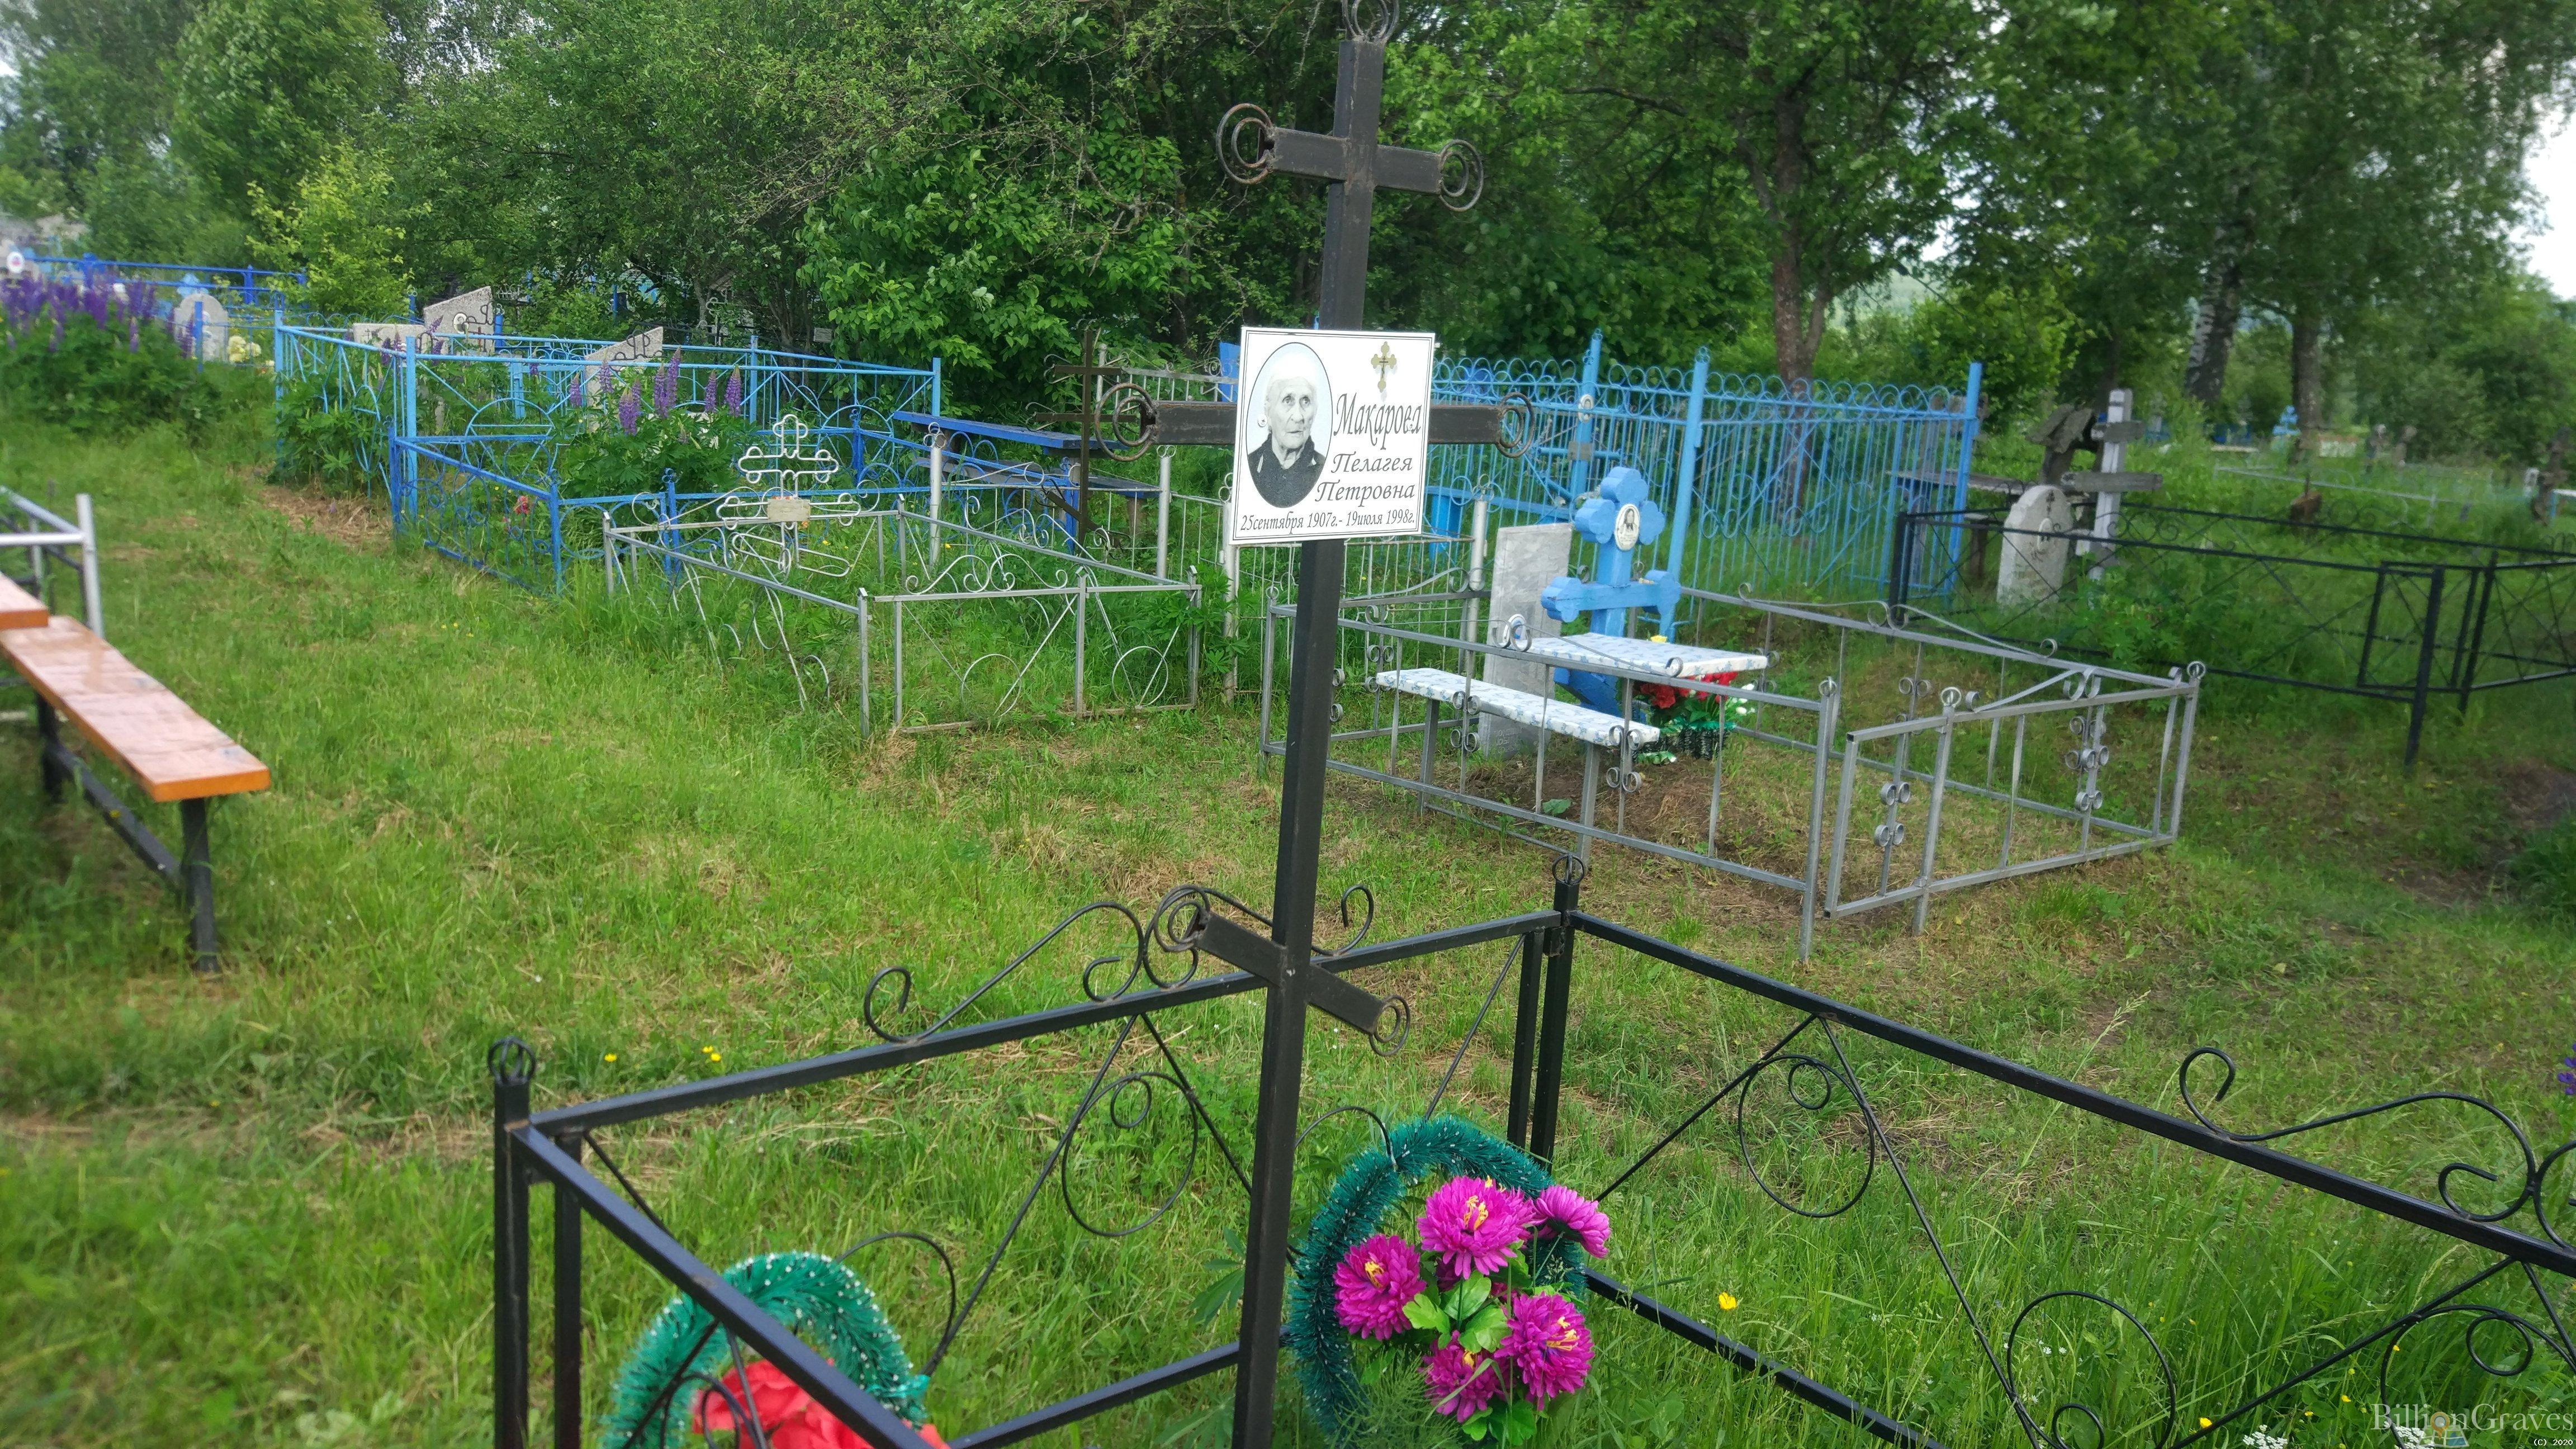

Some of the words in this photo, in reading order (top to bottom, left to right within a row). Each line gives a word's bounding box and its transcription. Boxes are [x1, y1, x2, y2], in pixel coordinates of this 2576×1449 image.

[1333, 392, 1422, 450] Макарова
[1330, 451, 1413, 473] Пелагея
[1315, 479, 1415, 508] Петровна
[1240, 511, 1304, 534] 25сентября
[1346, 510, 1383, 527] 19июля
[1385, 509, 1415, 524] 1998г.
